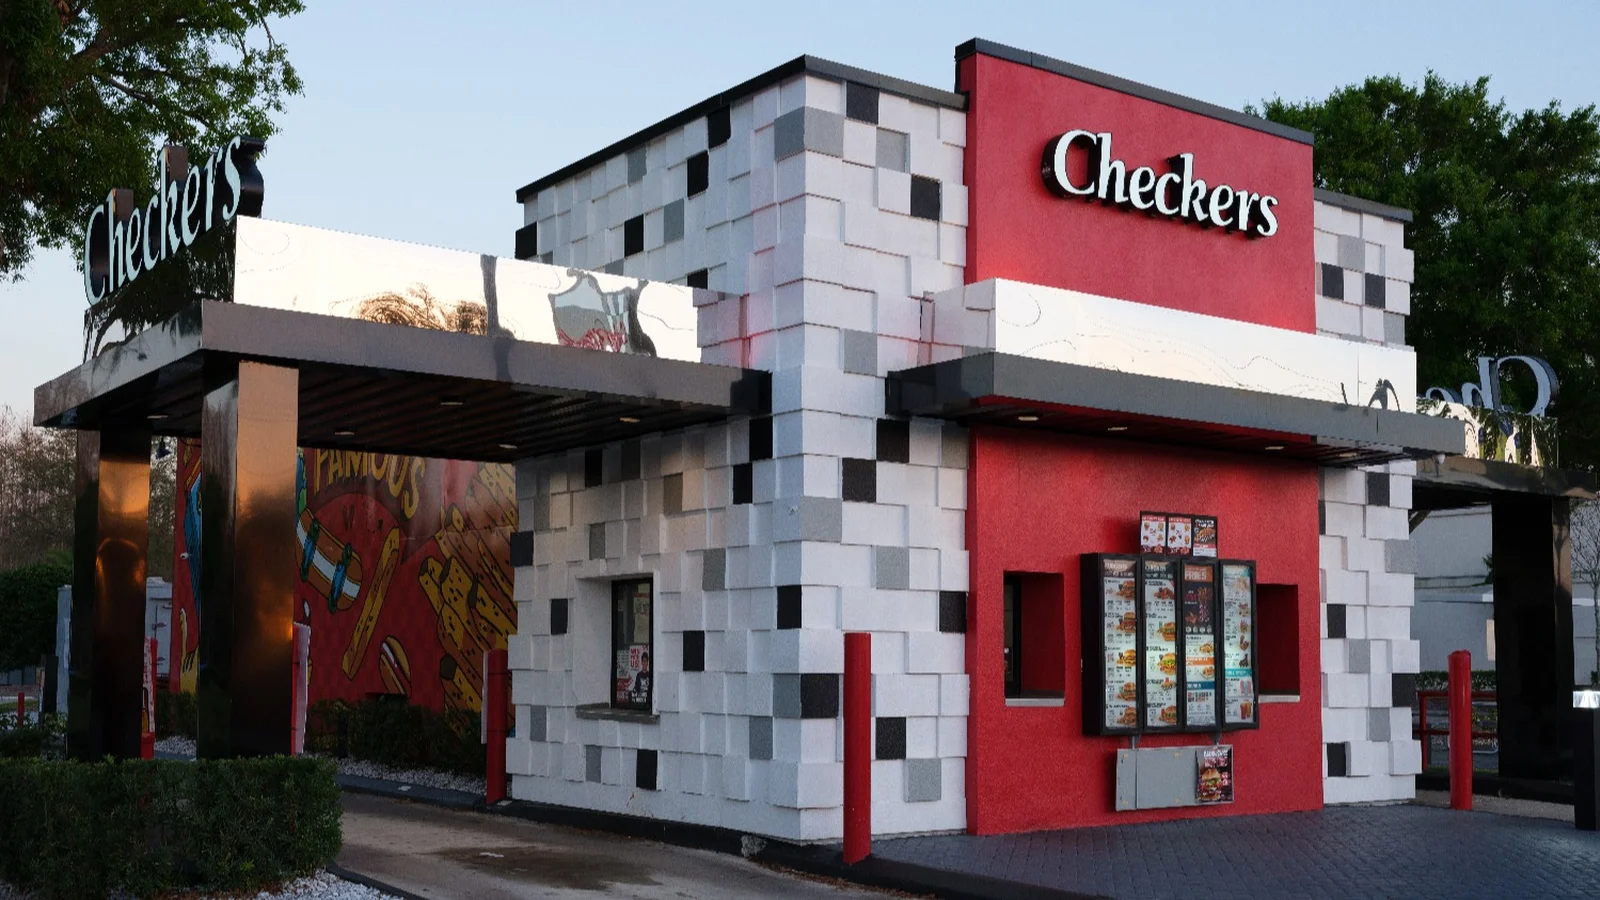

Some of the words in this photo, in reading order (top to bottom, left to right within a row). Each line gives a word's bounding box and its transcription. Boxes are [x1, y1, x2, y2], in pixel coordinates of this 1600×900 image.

[83, 135, 243, 307] Checkers
[1053, 129, 1280, 237] Checkers
[314, 447, 426, 520] FAMOUS
